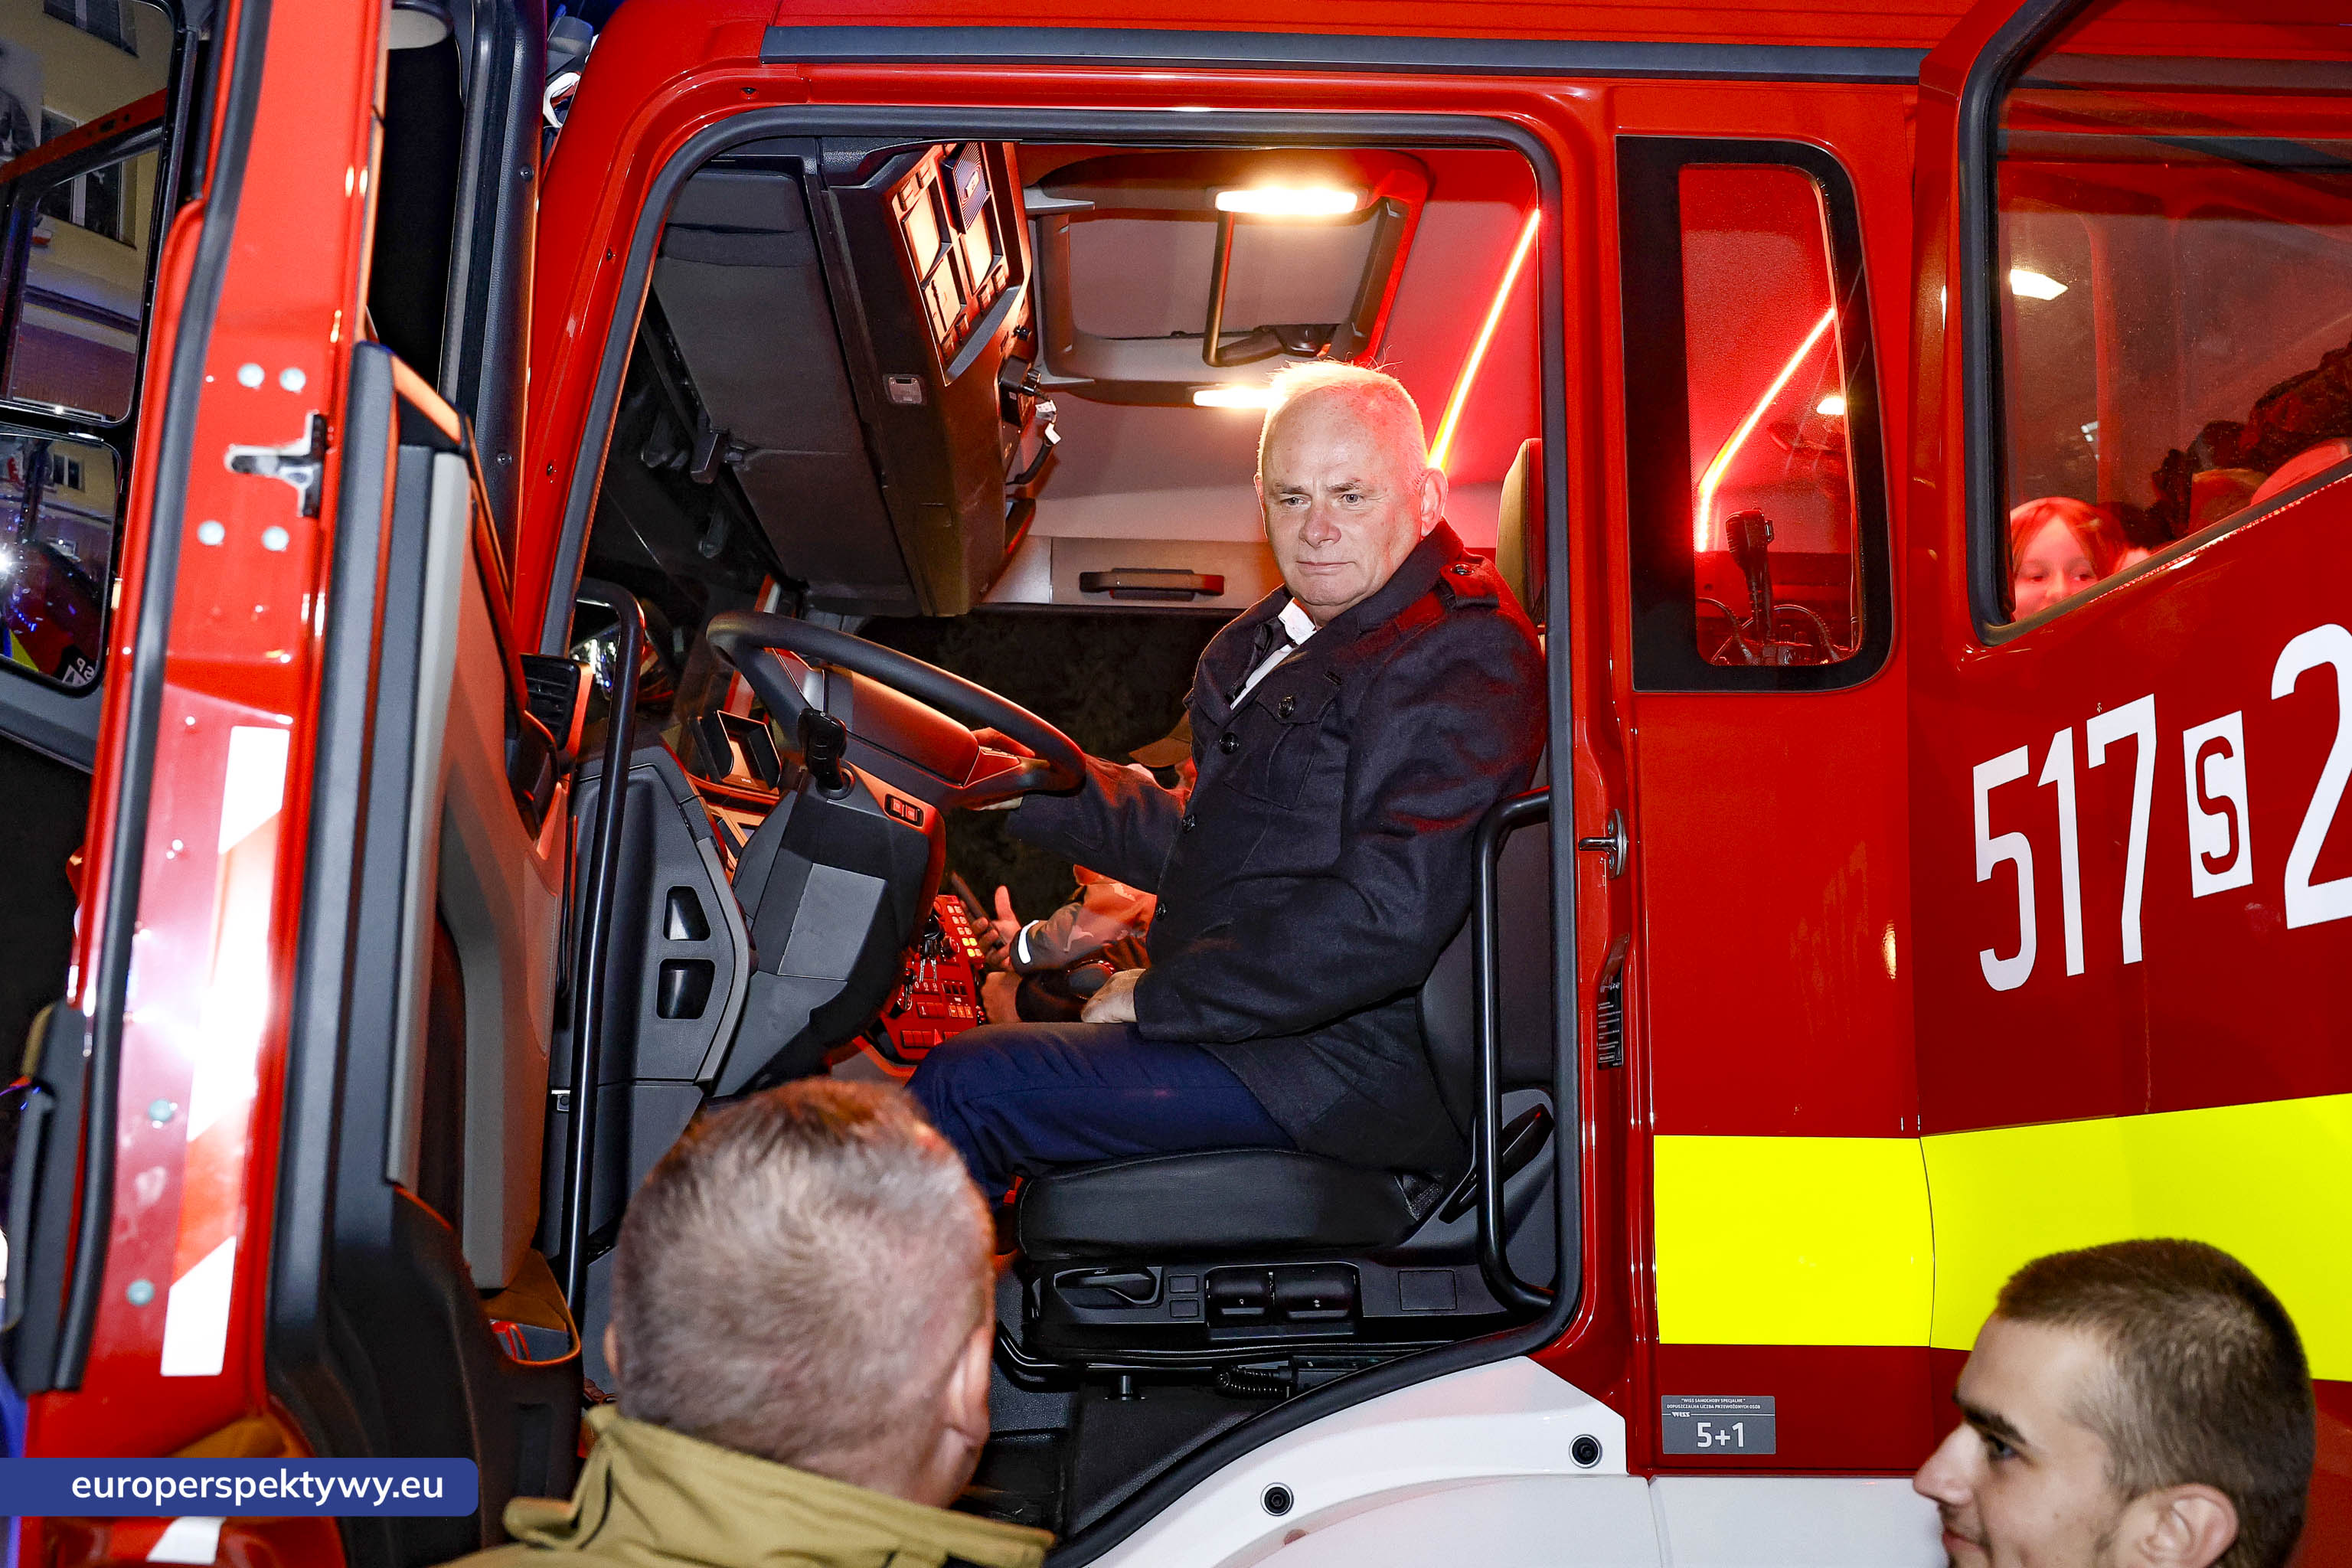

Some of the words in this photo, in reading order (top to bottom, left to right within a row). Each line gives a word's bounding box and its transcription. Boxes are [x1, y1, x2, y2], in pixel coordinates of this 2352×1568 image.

[1972, 693, 2157, 992] 517
[2192, 731, 2243, 880] S
[2271, 622, 2352, 930] 2
[1697, 1422, 1744, 1448] 5+1
